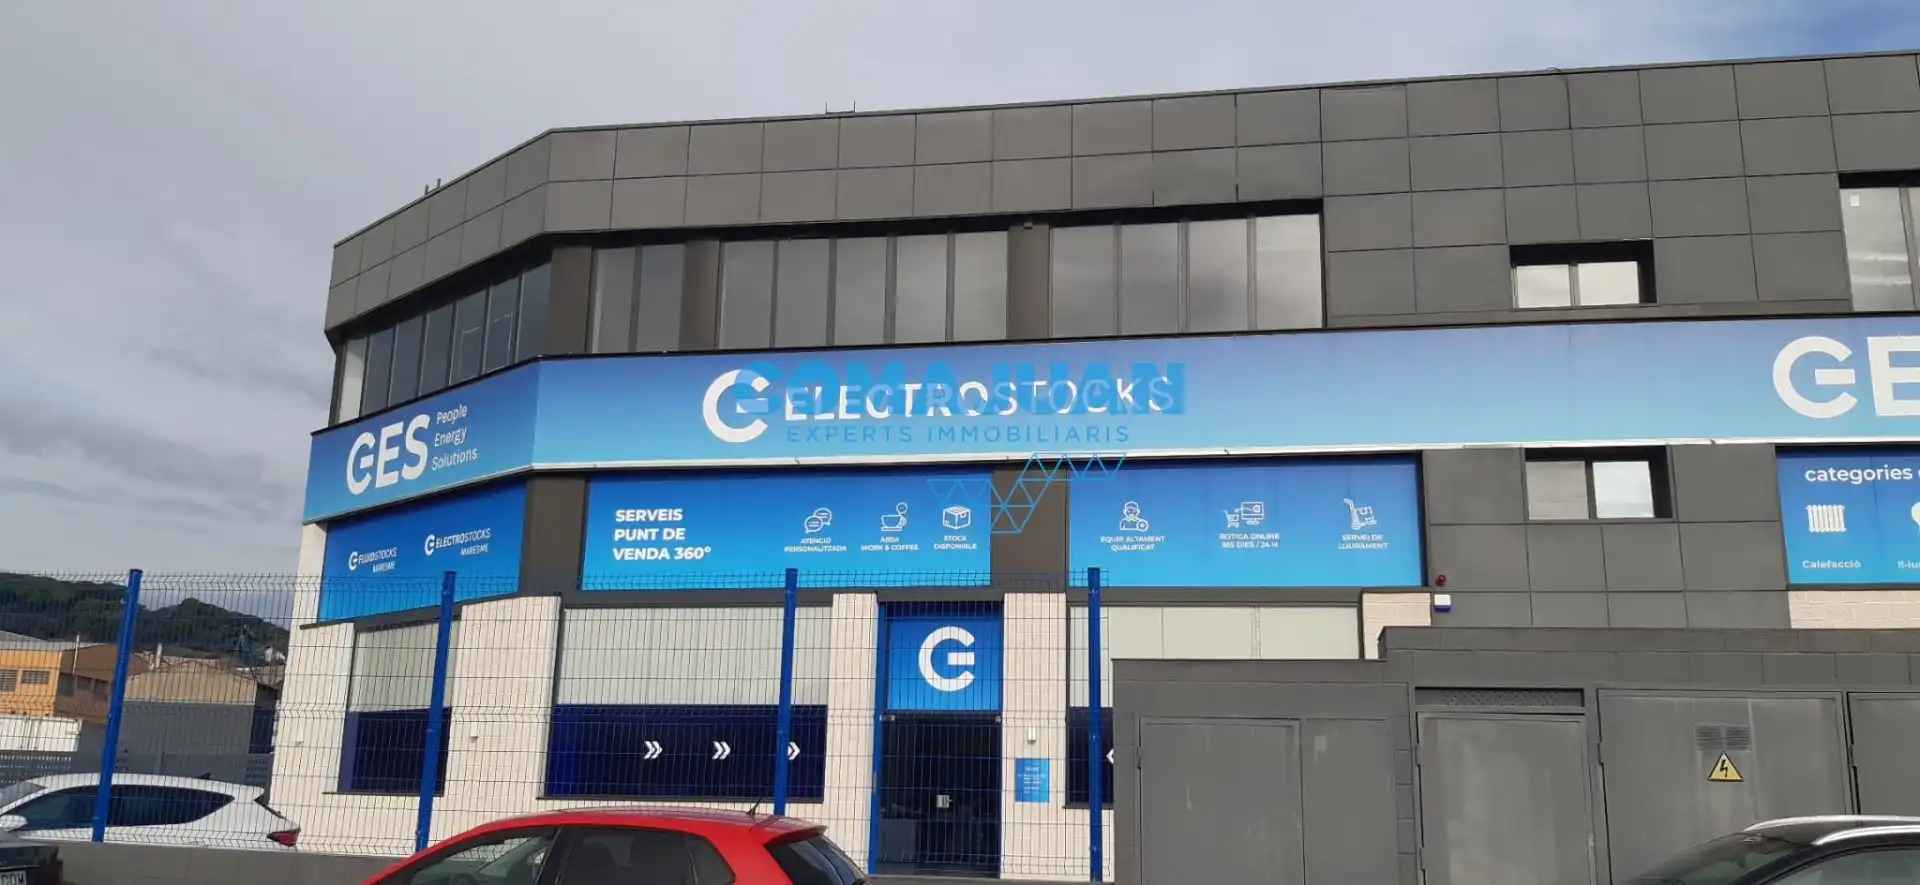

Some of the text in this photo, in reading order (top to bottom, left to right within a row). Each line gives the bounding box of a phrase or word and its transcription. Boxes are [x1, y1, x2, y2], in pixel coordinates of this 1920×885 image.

[784, 375, 1174, 421] ELECTROSTOCKS
[436, 404, 467, 425] People
[434, 427, 467, 447] Energy
[346, 414, 431, 496] GES
[431, 448, 478, 471] Solutions
[1804, 464, 1913, 485] categories
[615, 508, 684, 522] SERVEIS
[435, 528, 491, 549] ELECTROSTOCKS
[614, 527, 687, 542] PUNT DE
[612, 546, 671, 561] VENDA
